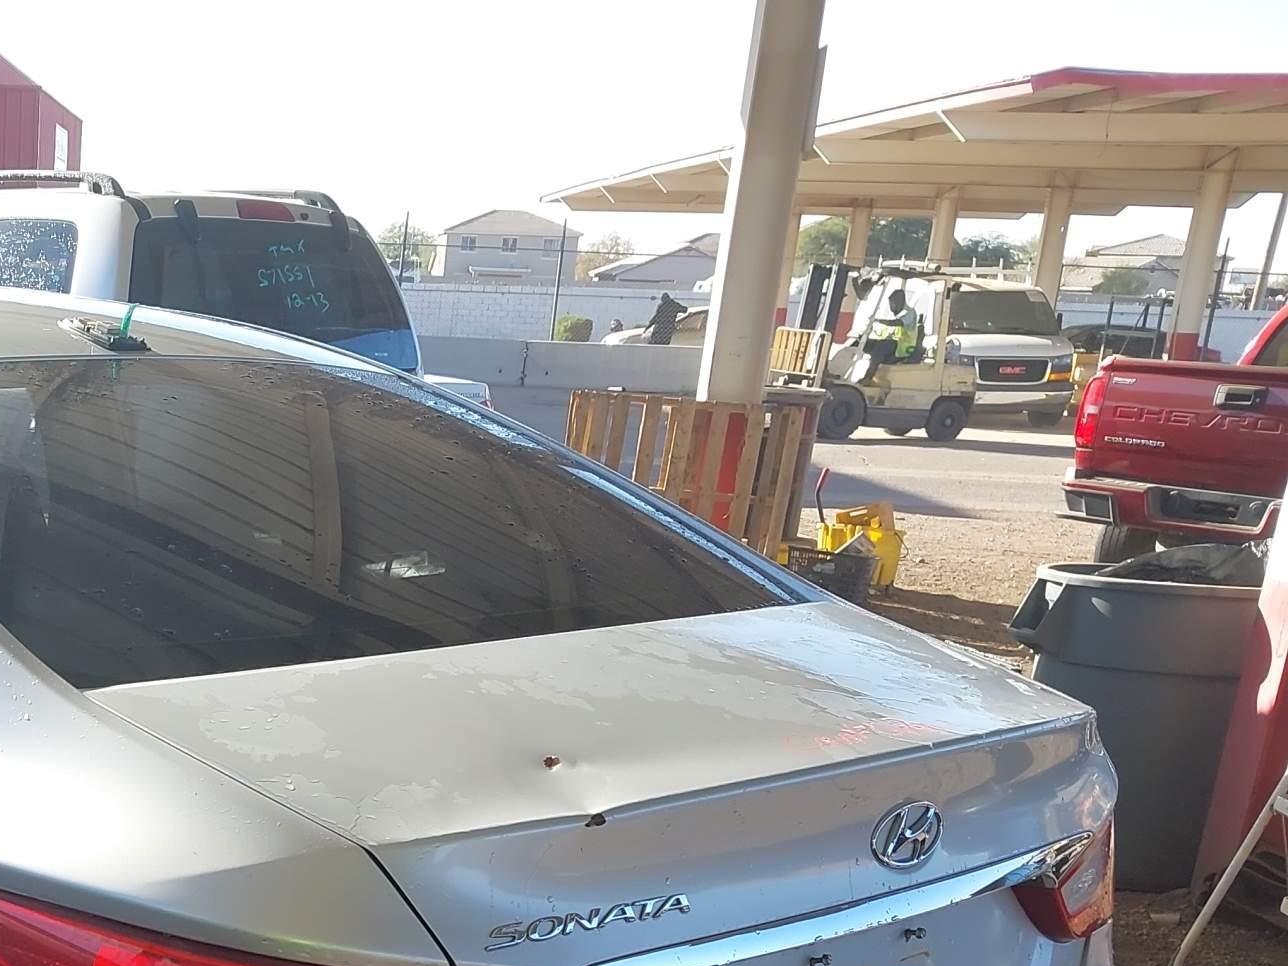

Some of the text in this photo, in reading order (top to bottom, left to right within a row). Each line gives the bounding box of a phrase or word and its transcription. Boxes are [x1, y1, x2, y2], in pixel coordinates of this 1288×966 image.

[999, 366, 1026, 374] GMC
[1115, 406, 1288, 436] CHEVRO
[1104, 434, 1166, 448] COLORADO
[484, 893, 691, 952] SONATA
